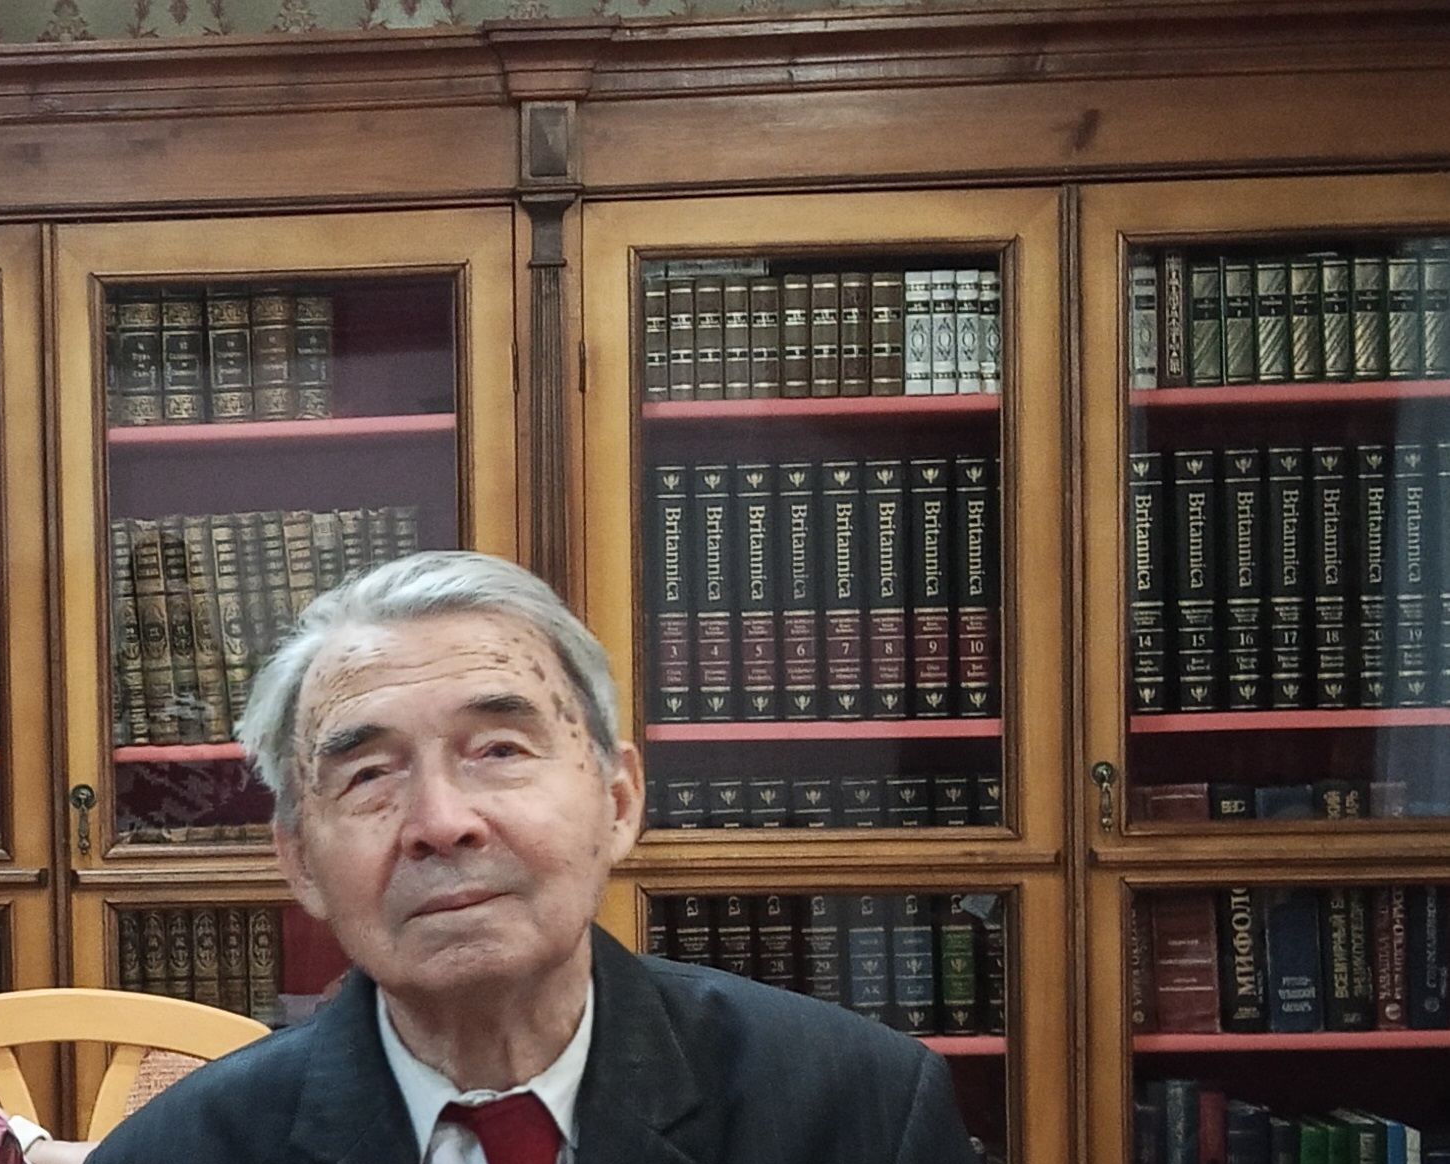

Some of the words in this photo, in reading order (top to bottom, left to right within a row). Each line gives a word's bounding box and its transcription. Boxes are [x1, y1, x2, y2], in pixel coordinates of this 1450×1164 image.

[1188, 492, 1206, 589] Britannica
[1237, 491, 1254, 587] Britannica
[1283, 489, 1300, 586] Britannica
[1324, 488, 1341, 586] Britannica
[1368, 487, 1385, 584] Britannica
[1407, 486, 1424, 583] Britannica
[924, 500, 941, 597] Britannica
[967, 499, 984, 596] Britannica
[1134, 494, 1152, 590] Britannica
[665, 507, 682, 602] Britannica
[706, 506, 723, 602] Britannica
[749, 505, 766, 601] Britannica
[791, 504, 808, 600] Britannica
[836, 503, 852, 599] Britannica
[879, 502, 895, 598] Britannica
[1138, 635, 1152, 647] 14
[1192, 634, 1206, 647] 15
[1239, 632, 1254, 646] 16
[1283, 630, 1298, 645] 17
[1326, 631, 1340, 643] 18
[1367, 630, 1384, 642] 20
[1409, 629, 1423, 640] 19
[670, 645, 678, 658] 3
[710, 645, 719, 657] 4
[755, 644, 763, 657] 5
[796, 644, 806, 657] 6
[842, 642, 850, 656] 7
[885, 642, 893, 654] 8
[928, 640, 938, 653] 9
[970, 640, 984, 653] 10
[770, 961, 785, 973] 28
[814, 960, 830, 973] 29
